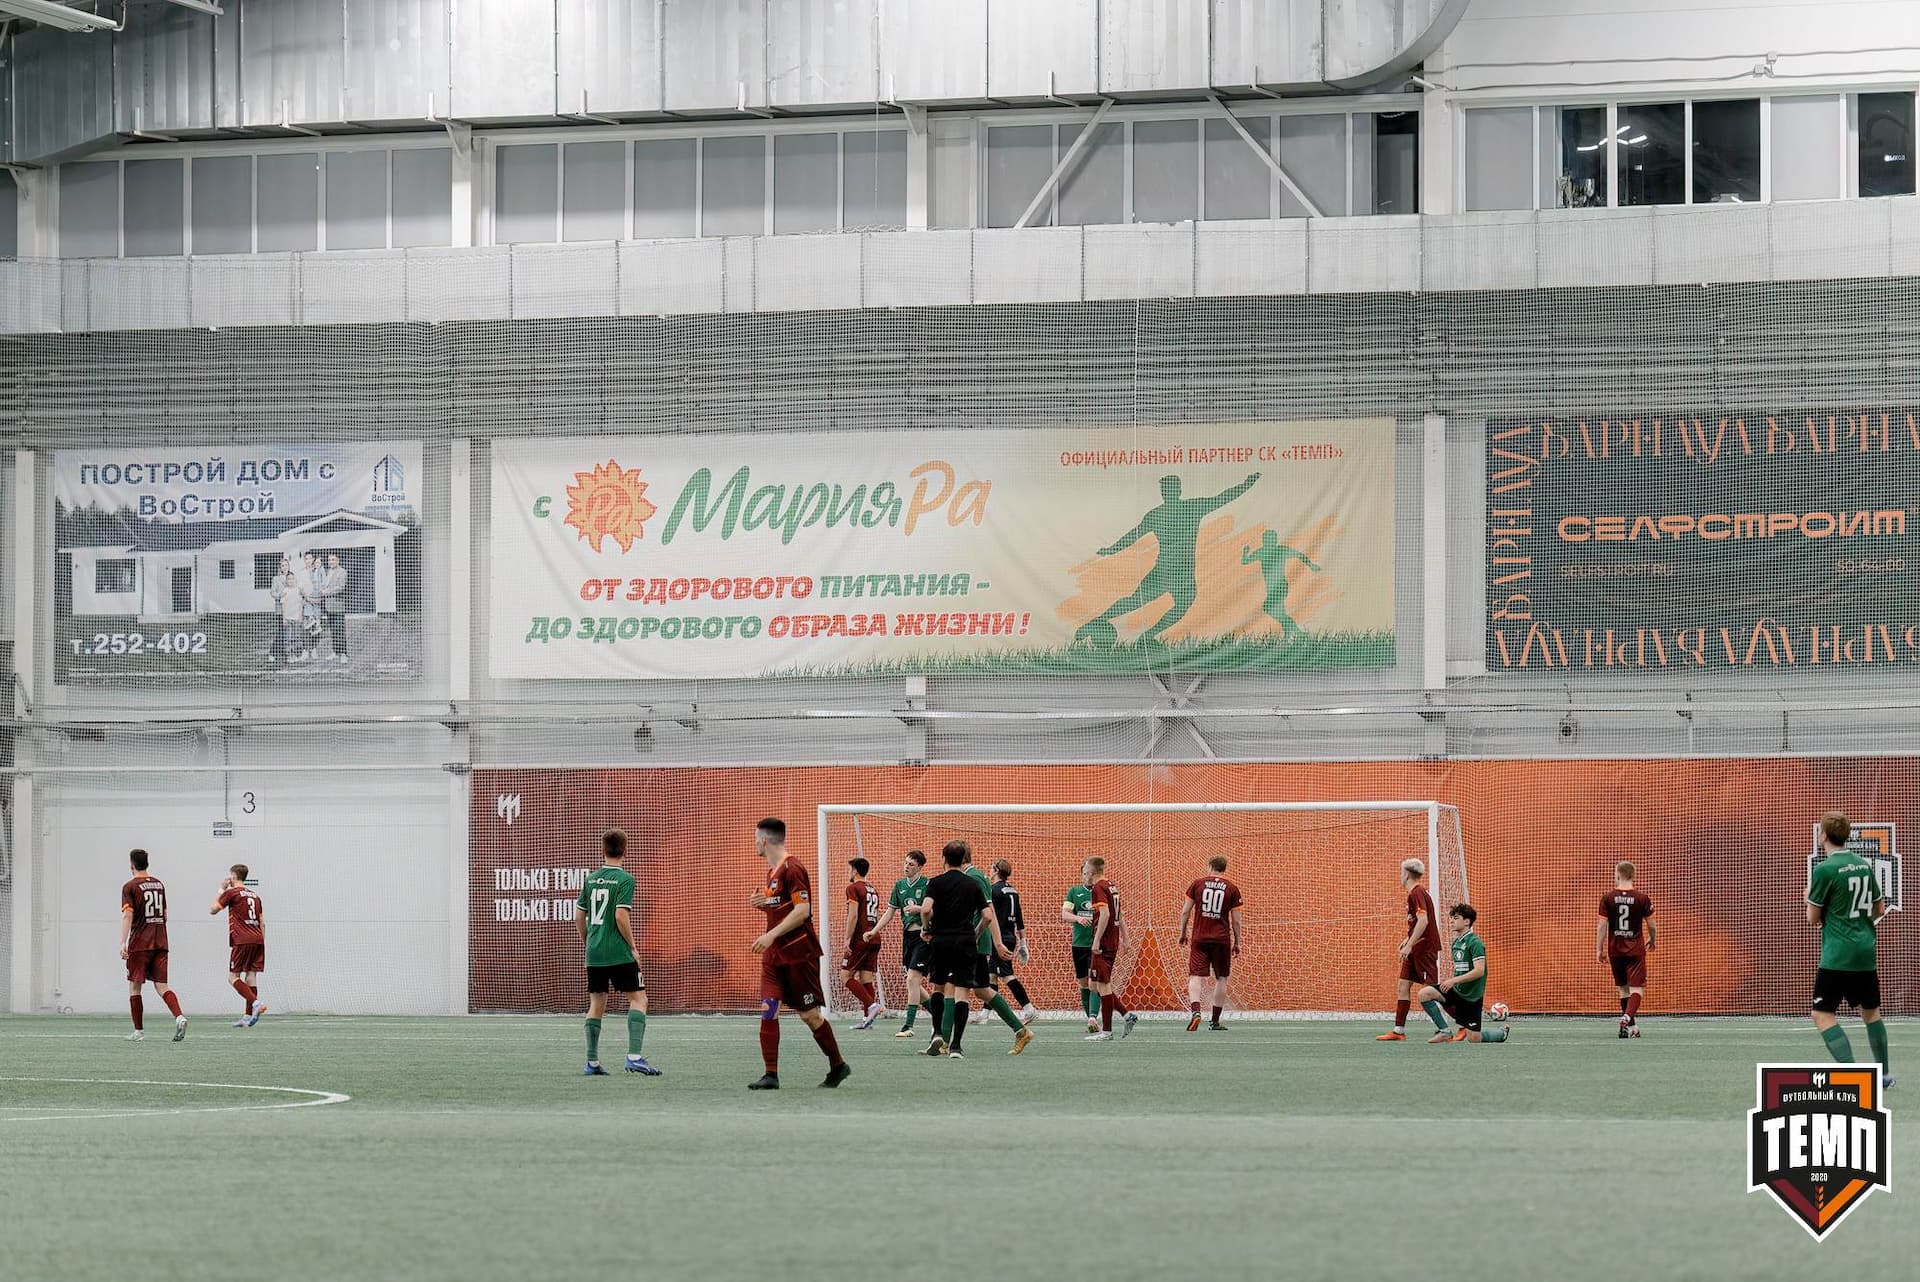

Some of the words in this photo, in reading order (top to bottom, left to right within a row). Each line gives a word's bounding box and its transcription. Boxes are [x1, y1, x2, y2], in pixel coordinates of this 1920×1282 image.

[1060, 445, 1183, 469] ОФИЦИАЛЬНЫЙ
[1189, 447, 1253, 464] ПАРТНЕР
[1259, 445, 1276, 461] СК
[1282, 443, 1344, 461] «ТЕМП»
[80, 456, 226, 485] ПОСТРОЙ
[236, 458, 309, 486] ДОМ
[138, 491, 275, 519] ВоСтрой
[580, 577, 621, 601] ОТ
[626, 575, 813, 605] ЗДОРОВОГО
[820, 572, 971, 599] ПИТАНИЯ
[525, 616, 572, 644] ДО
[576, 614, 762, 644] ЗДОРОВОГО
[768, 613, 888, 638] ОБРАЗА
[70, 632, 208, 655] т.252-402
[243, 791, 256, 814] 3
[495, 868, 549, 891] ТОЛЬКО
[144, 890, 163, 918] 24
[247, 897, 256, 920] 3
[495, 899, 549, 921] ТОЛЬКО
[1202, 888, 1225, 914] 90
[1848, 875, 1873, 919] 24
[1618, 904, 1629, 931] 2
